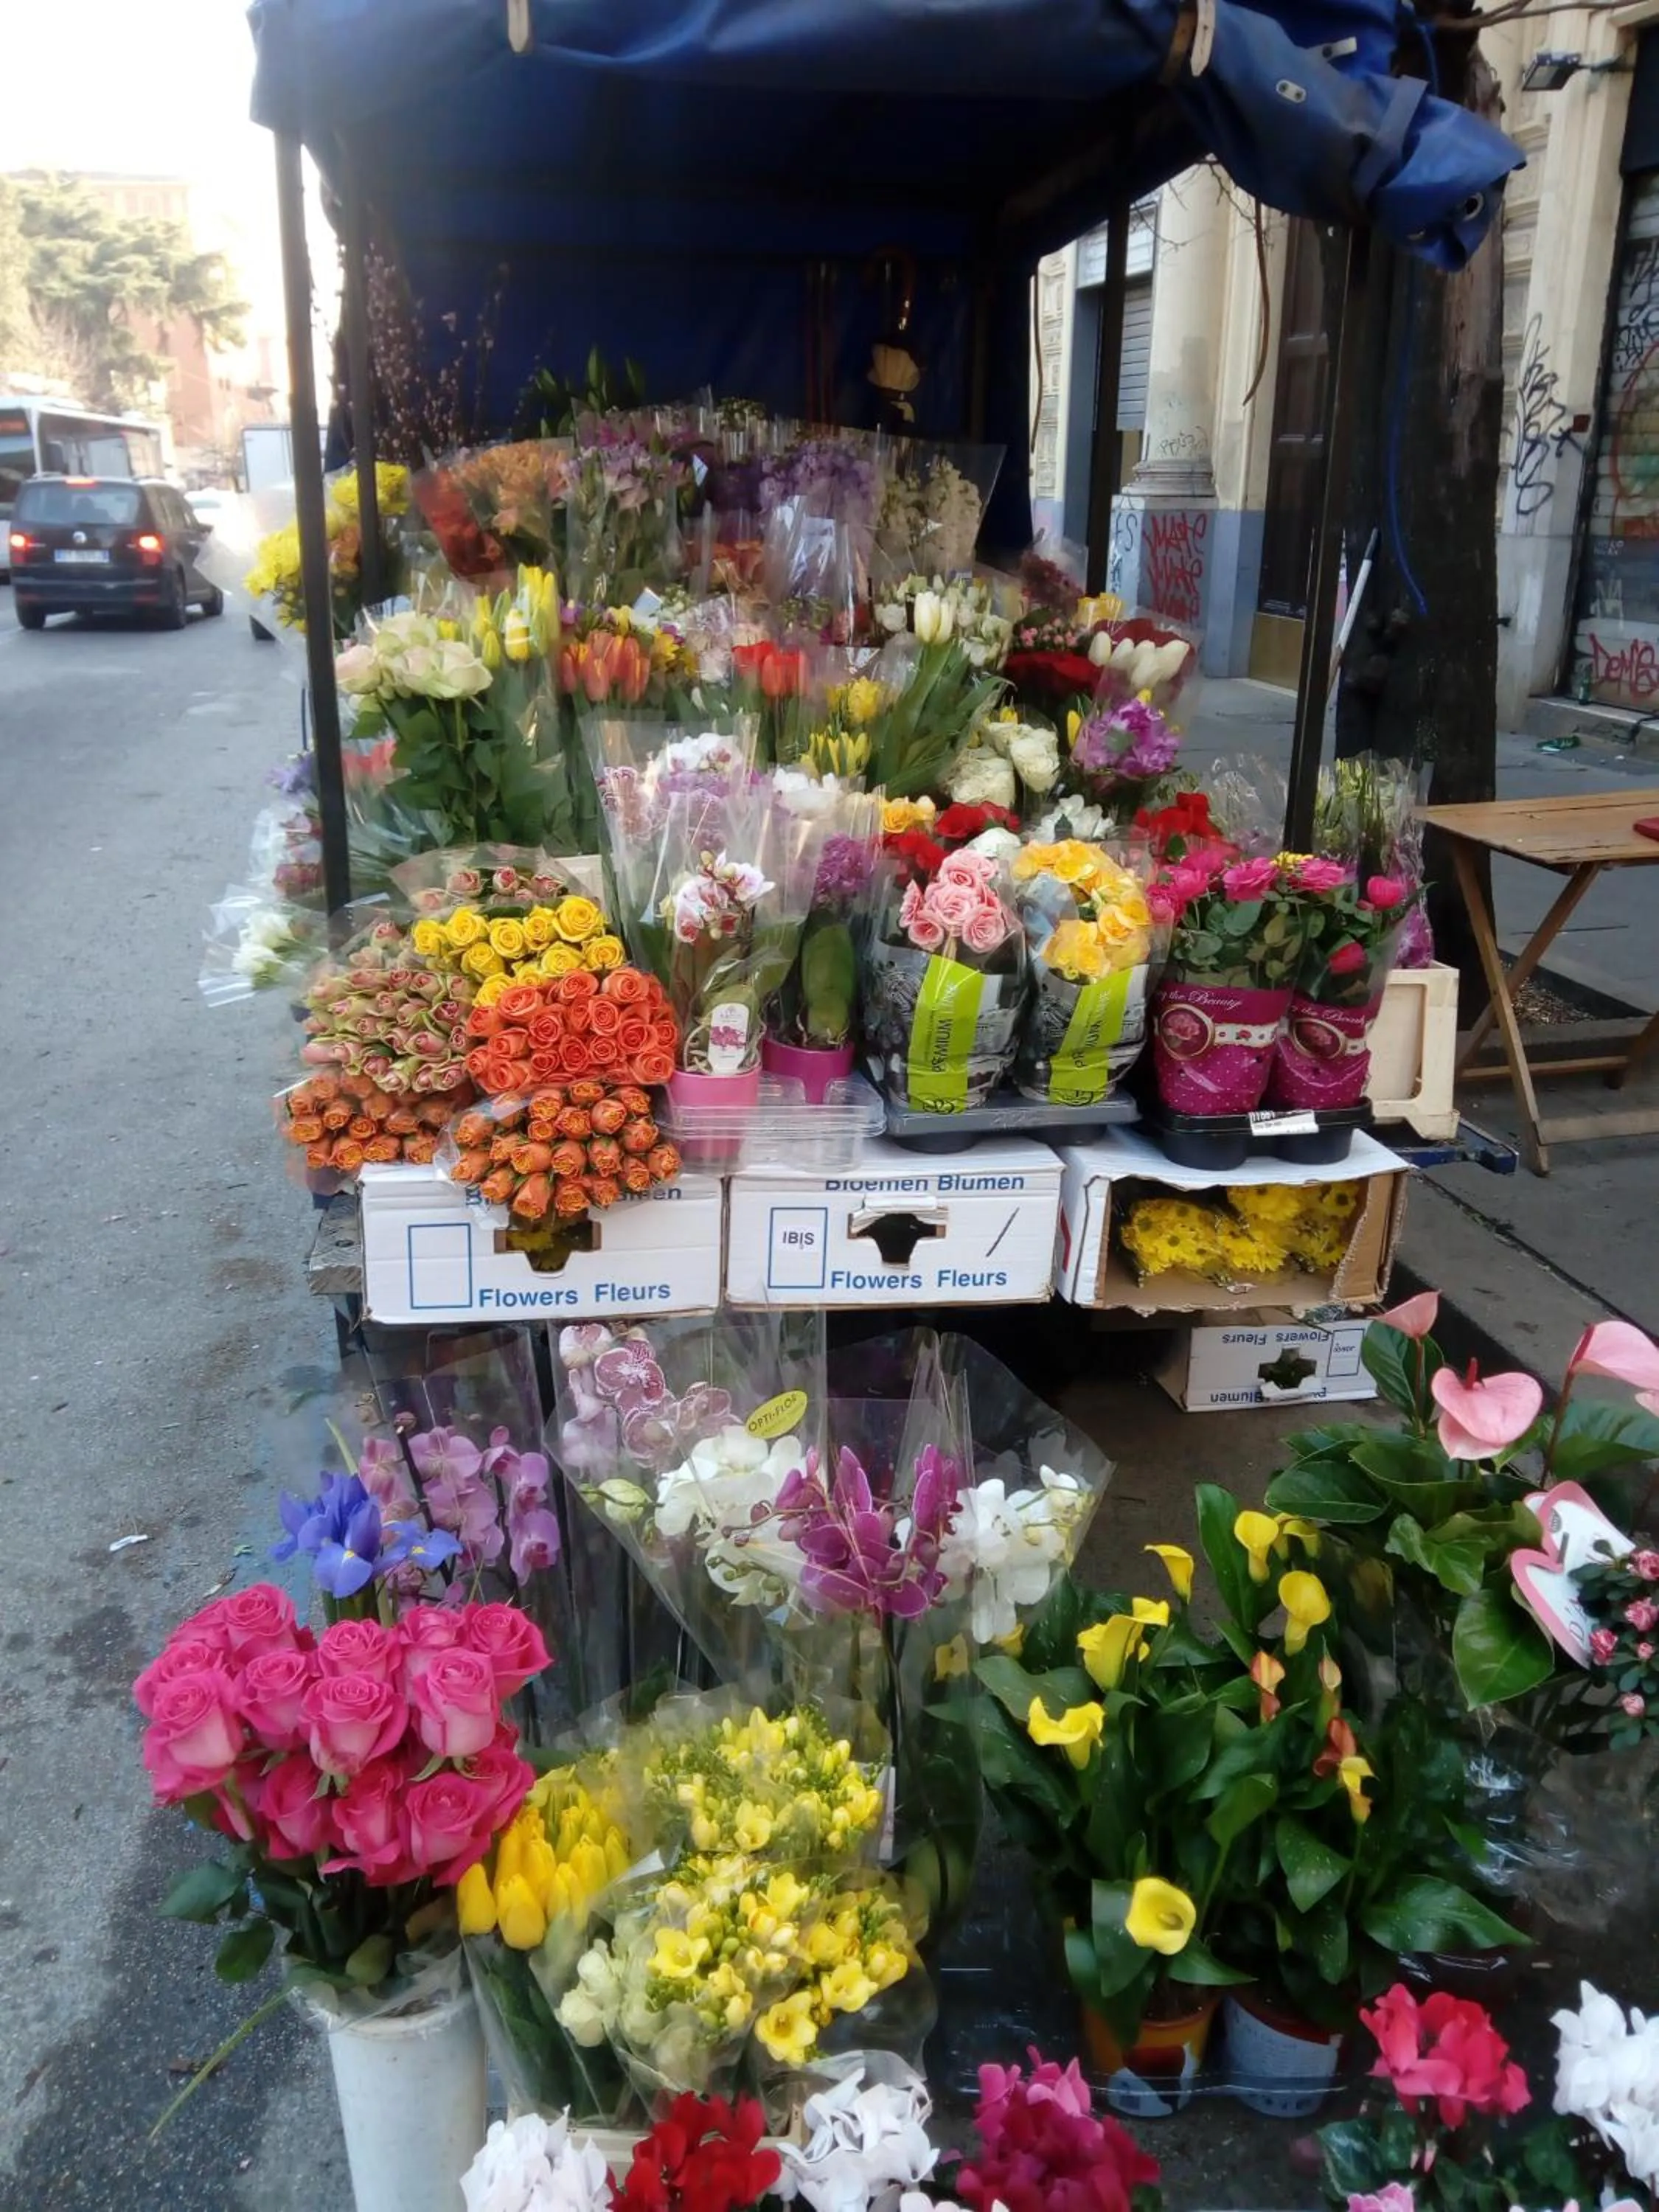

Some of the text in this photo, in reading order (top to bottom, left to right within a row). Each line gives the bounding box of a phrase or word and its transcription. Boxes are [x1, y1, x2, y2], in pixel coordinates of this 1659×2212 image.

[937, 1175, 1024, 1191] Blumen
[782, 1231, 815, 1246] IBIS
[831, 1269, 1008, 1290] Flowers Fleurs
[479, 1283, 671, 1307] Flowers Fleurs
[1222, 1332, 1329, 1345] Flowers Fleurs
